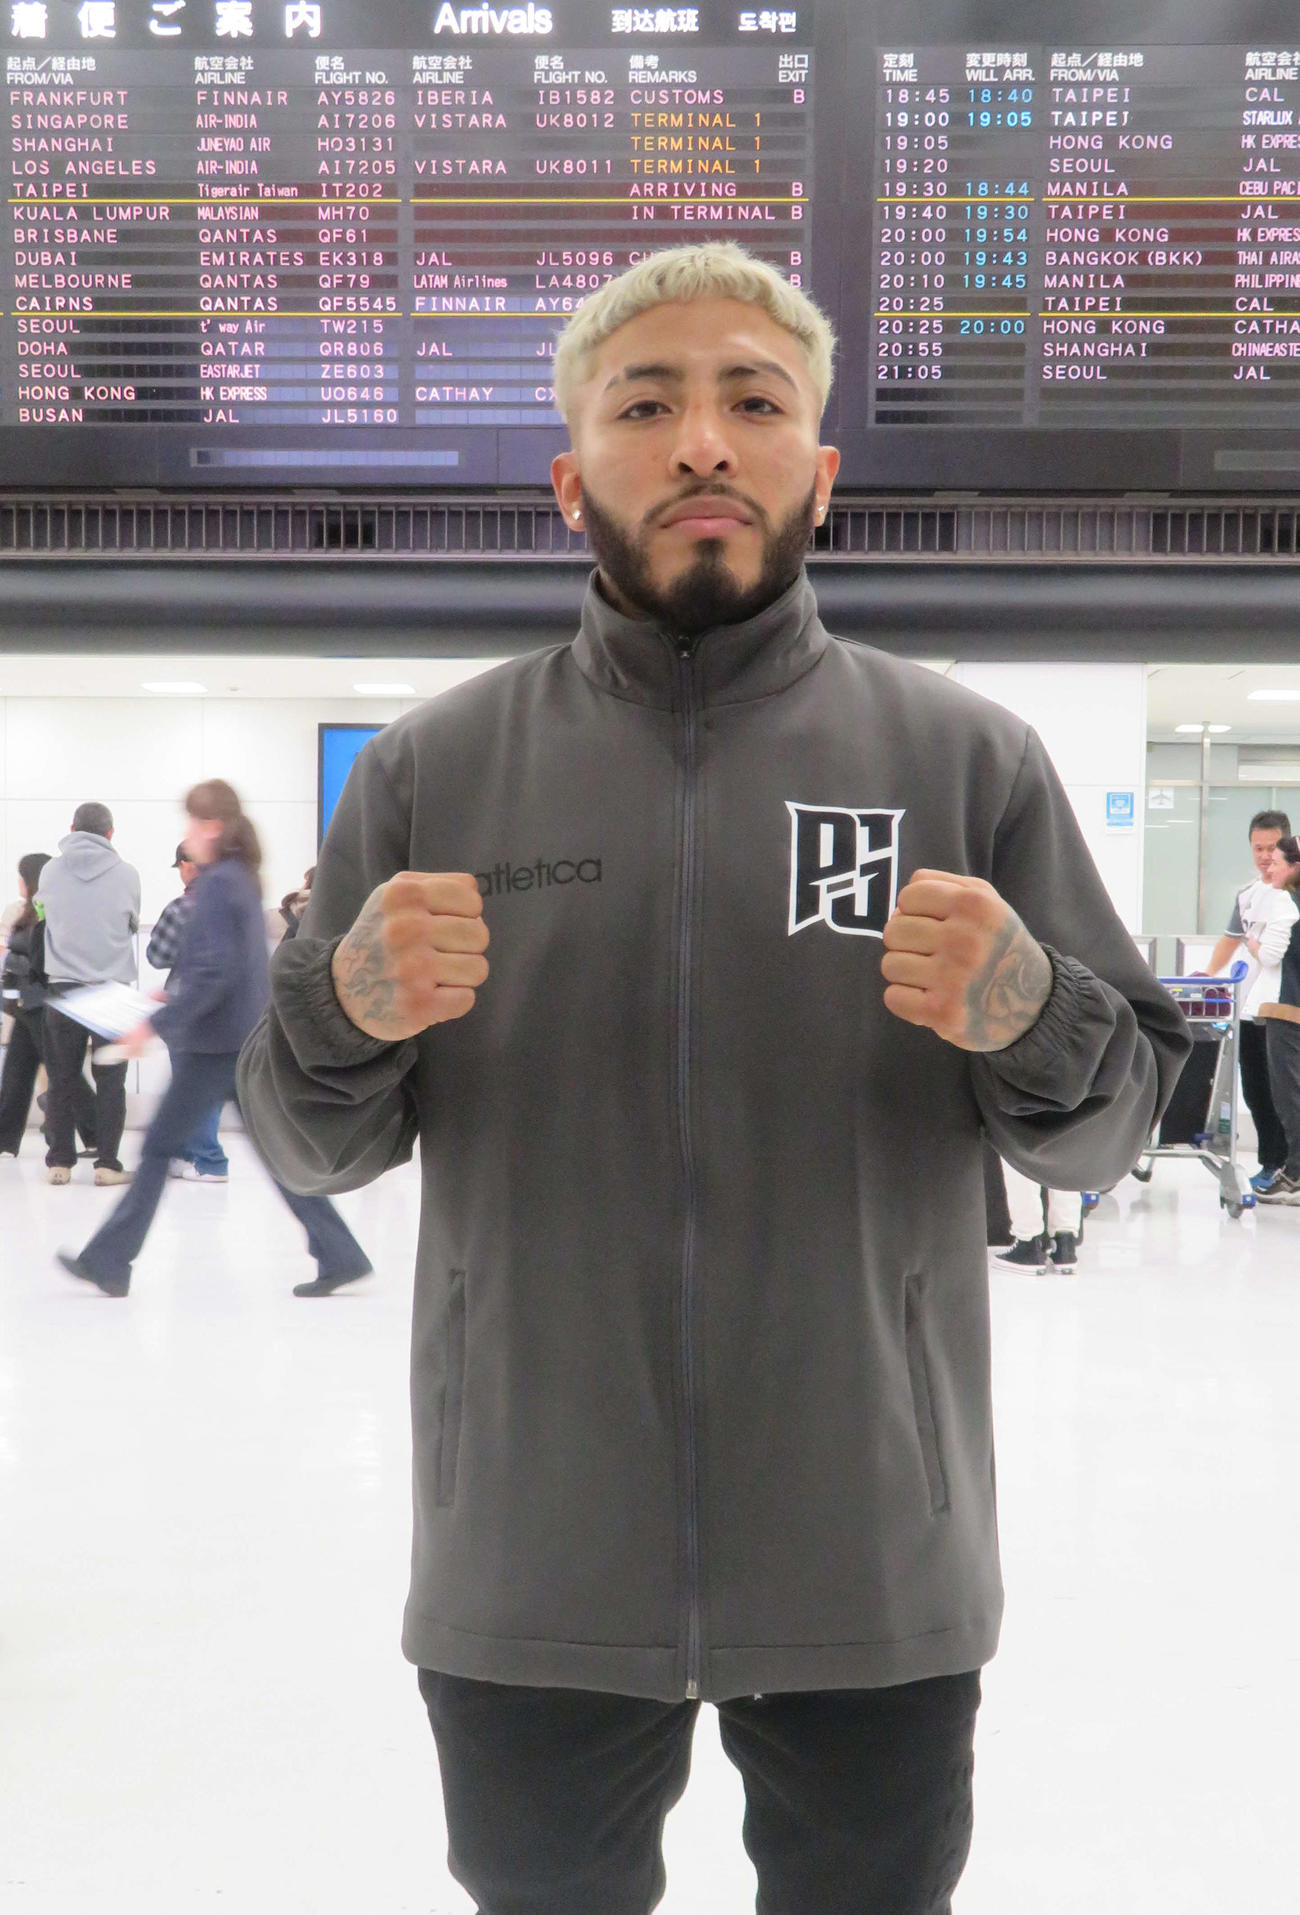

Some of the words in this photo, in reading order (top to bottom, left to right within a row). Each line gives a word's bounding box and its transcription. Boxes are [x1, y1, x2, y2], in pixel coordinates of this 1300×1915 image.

[434, 3, 552, 34] Arrivals
[612, 8, 698, 33] 到达航班
[738, 13, 796, 31] 도착편
[195, 56, 253, 73] 航空会社
[316, 56, 344, 70] 便名
[413, 56, 472, 69] 航空会社
[535, 55, 564, 69] 便名
[629, 55, 658, 69] 備考
[779, 54, 808, 68] 出口
[883, 54, 914, 67] 定刻
[966, 54, 1027, 67] 変更時刻
[7, 73, 73, 85] FROM/VIA
[195, 72, 245, 84] AIRLINE
[315, 72, 361, 84] FLIGHT
[366, 72, 388, 84] NO.
[413, 71, 464, 83] AIRLINE
[534, 71, 581, 83] FLIGHT
[585, 71, 607, 83] NO.
[629, 71, 696, 83] REMARKS
[779, 70, 808, 82] EXIT
[883, 69, 917, 81] TIME
[966, 69, 998, 81] WILL
[1003, 69, 1035, 81] ARR.
[1050, 69, 1119, 81] FROM/VIA
[1245, 68, 1297, 81] AIRLINE
[11, 91, 127, 105] FRANKFURT
[198, 91, 287, 105] FINNAIR
[318, 91, 394, 105] AY5826
[418, 91, 493, 105] IBERIA
[539, 90, 614, 104] IB1582
[631, 90, 723, 104] CUSTOMS
[794, 89, 804, 103] B
[887, 89, 949, 103] 18:45
[970, 89, 1032, 102] 18:40
[1053, 88, 1129, 102] TAIPEI
[1246, 88, 1284, 101] CAL
[12, 114, 128, 128] SINGAPORE
[197, 114, 257, 128] AIR-INDIA
[318, 114, 395, 128] AI7206
[415, 114, 506, 128] VISTARA
[537, 113, 613, 127] UK8012
[631, 113, 735, 127] TERMINAL
[886, 112, 948, 126] 19:00
[968, 111, 1031, 126] 19:05
[1243, 111, 1293, 125] STARLUX
[13, 138, 112, 151] SHANGHAI
[197, 138, 243, 151] JUNEYAO
[250, 138, 270, 151] AIR
[318, 137, 392, 151] HO3131
[631, 136, 735, 150] TERMINAL
[886, 136, 947, 150] 19:05
[1050, 135, 1102, 149] HONG
[1119, 135, 1172, 149] KONG
[1242, 135, 1256, 148] HK
[13, 160, 49, 174] LOS
[66, 160, 155, 174] ANGELES
[197, 160, 257, 174] AIR-INDIA
[319, 160, 395, 174] AI7205
[415, 160, 506, 174] VISTARA
[537, 160, 610, 174] UK8011
[631, 160, 734, 173] TERMINAL
[885, 159, 947, 173] 19:20
[1050, 159, 1114, 172] SEOUL
[1243, 158, 1280, 172] JAL
[13, 183, 87, 197] TAIPEI
[199, 184, 249, 198] Tigerair
[258, 183, 298, 196] Taiwan
[322, 183, 382, 197] IT202
[630, 183, 736, 196] ARRIVING
[792, 182, 803, 196] B
[884, 182, 947, 196] 19:30
[966, 182, 1028, 196] 18:44
[1048, 182, 1128, 196] MANILA
[1240, 181, 1268, 195] CEBU
[14, 207, 77, 220] KUALA
[94, 206, 169, 220] LUMPUR
[198, 206, 258, 220] MALAYSIAN
[319, 206, 369, 220] MH70
[633, 206, 653, 219] IN
[671, 206, 775, 219] TERMINAL
[792, 206, 802, 219] B
[884, 206, 946, 219] 19:40
[966, 206, 1028, 219] 19:30
[1048, 205, 1124, 219] TAIPEI
[1242, 205, 1278, 218] JAL
[15, 229, 117, 243] BRISBANE
[199, 229, 276, 243] QANTAS
[319, 229, 366, 243] QF61
[882, 229, 945, 242] 20:00
[966, 229, 1027, 242] 19:54
[1047, 228, 1099, 242] HONG
[1116, 228, 1168, 242] KONG
[1237, 228, 1251, 241] HK
[16, 252, 76, 265] DUBAI
[201, 252, 303, 265] EMIRATES
[320, 252, 383, 265] EK318
[417, 252, 452, 265] JAL
[537, 252, 612, 265] JL5096
[881, 252, 944, 265] 20:00
[965, 252, 1026, 265] 19:43
[1046, 252, 1138, 265] BANGKOK
[1148, 251, 1201, 265] (BKK)
[1238, 251, 1262, 264] THAI
[15, 274, 131, 288] MELBOURNE
[200, 274, 277, 288] QANTAS
[319, 274, 369, 288] QF79
[414, 275, 448, 288] LATAM
[454, 275, 507, 288] Airlines
[880, 274, 944, 288] 20:10
[964, 275, 1025, 288] 19:45
[1045, 274, 1124, 288] MANILA
[16, 296, 92, 310] CAIRNS
[200, 297, 277, 311] QANTAS
[320, 297, 396, 311] QF5545
[415, 297, 505, 311] FINNAIR
[880, 297, 943, 311] 20:25
[1045, 297, 1121, 311] TAIPEI
[1236, 297, 1273, 311] CAL
[18, 319, 79, 333] SEOUL
[246, 320, 265, 333] Air
[320, 320, 383, 333] TW215
[879, 320, 942, 334] 20:25
[961, 320, 1024, 333] 20:00
[1044, 320, 1095, 333] HONG
[1112, 320, 1164, 333] KONG
[18, 342, 67, 355] DOHA
[202, 342, 264, 355] QATAR
[320, 342, 383, 356] QR806
[417, 343, 452, 356] JAL
[879, 343, 942, 356] 20:55
[1044, 343, 1146, 356] SHANGHAI
[19, 364, 80, 377] SEOUL
[201, 364, 260, 378] EASTARJET
[321, 364, 384, 378] ZE603
[878, 365, 941, 379] 21:05
[1043, 365, 1106, 379] SEOUL
[1234, 366, 1270, 379] JAL
[19, 386, 69, 400] HONG
[85, 386, 135, 400] KONG
[201, 387, 214, 400] HK
[220, 386, 267, 400] EXPRESS
[320, 387, 384, 401] UO646
[416, 387, 492, 400] CATHAY
[20, 408, 82, 422] BUSAN
[204, 410, 239, 422] JAL
[320, 409, 398, 423] JL5160
[474, 857, 601, 898] atletica
